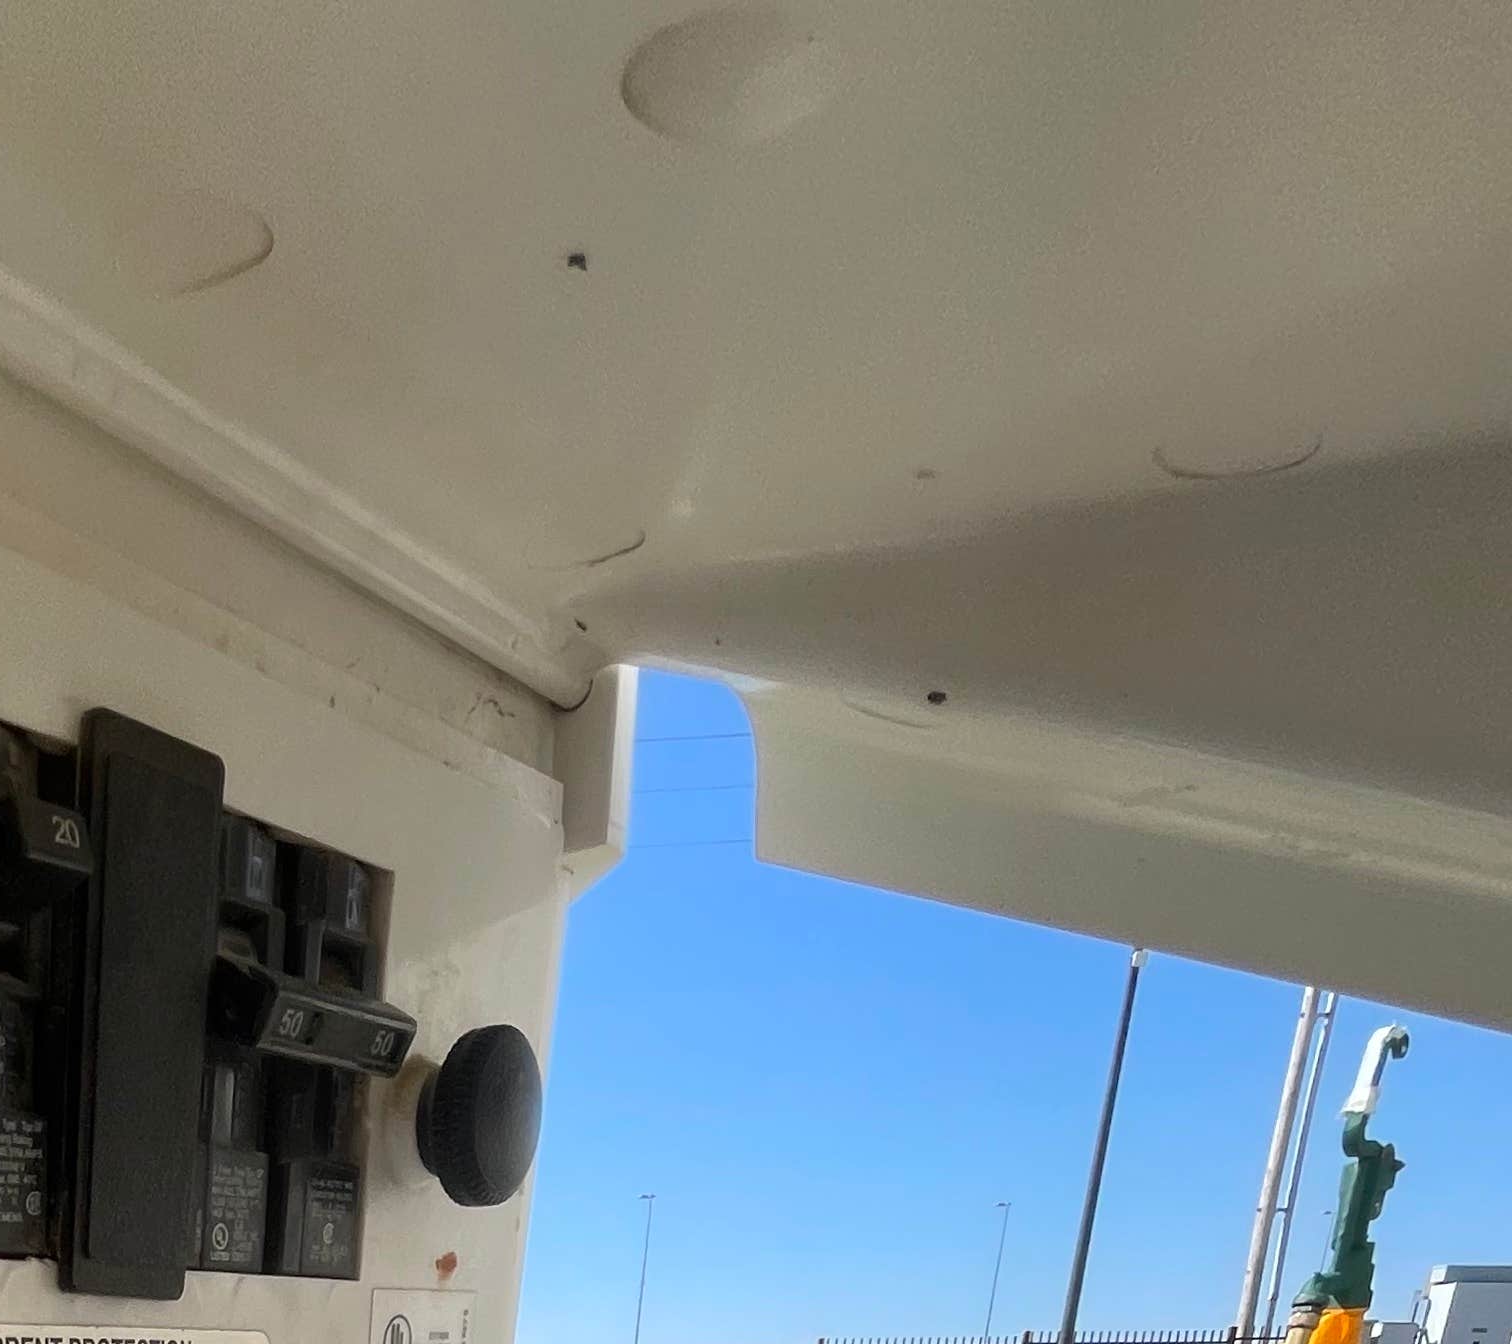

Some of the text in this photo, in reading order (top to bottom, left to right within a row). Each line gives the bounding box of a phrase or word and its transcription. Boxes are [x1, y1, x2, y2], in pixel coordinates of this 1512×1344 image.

[52, 815, 80, 848] 20
[280, 1009, 395, 1056] 50 50
